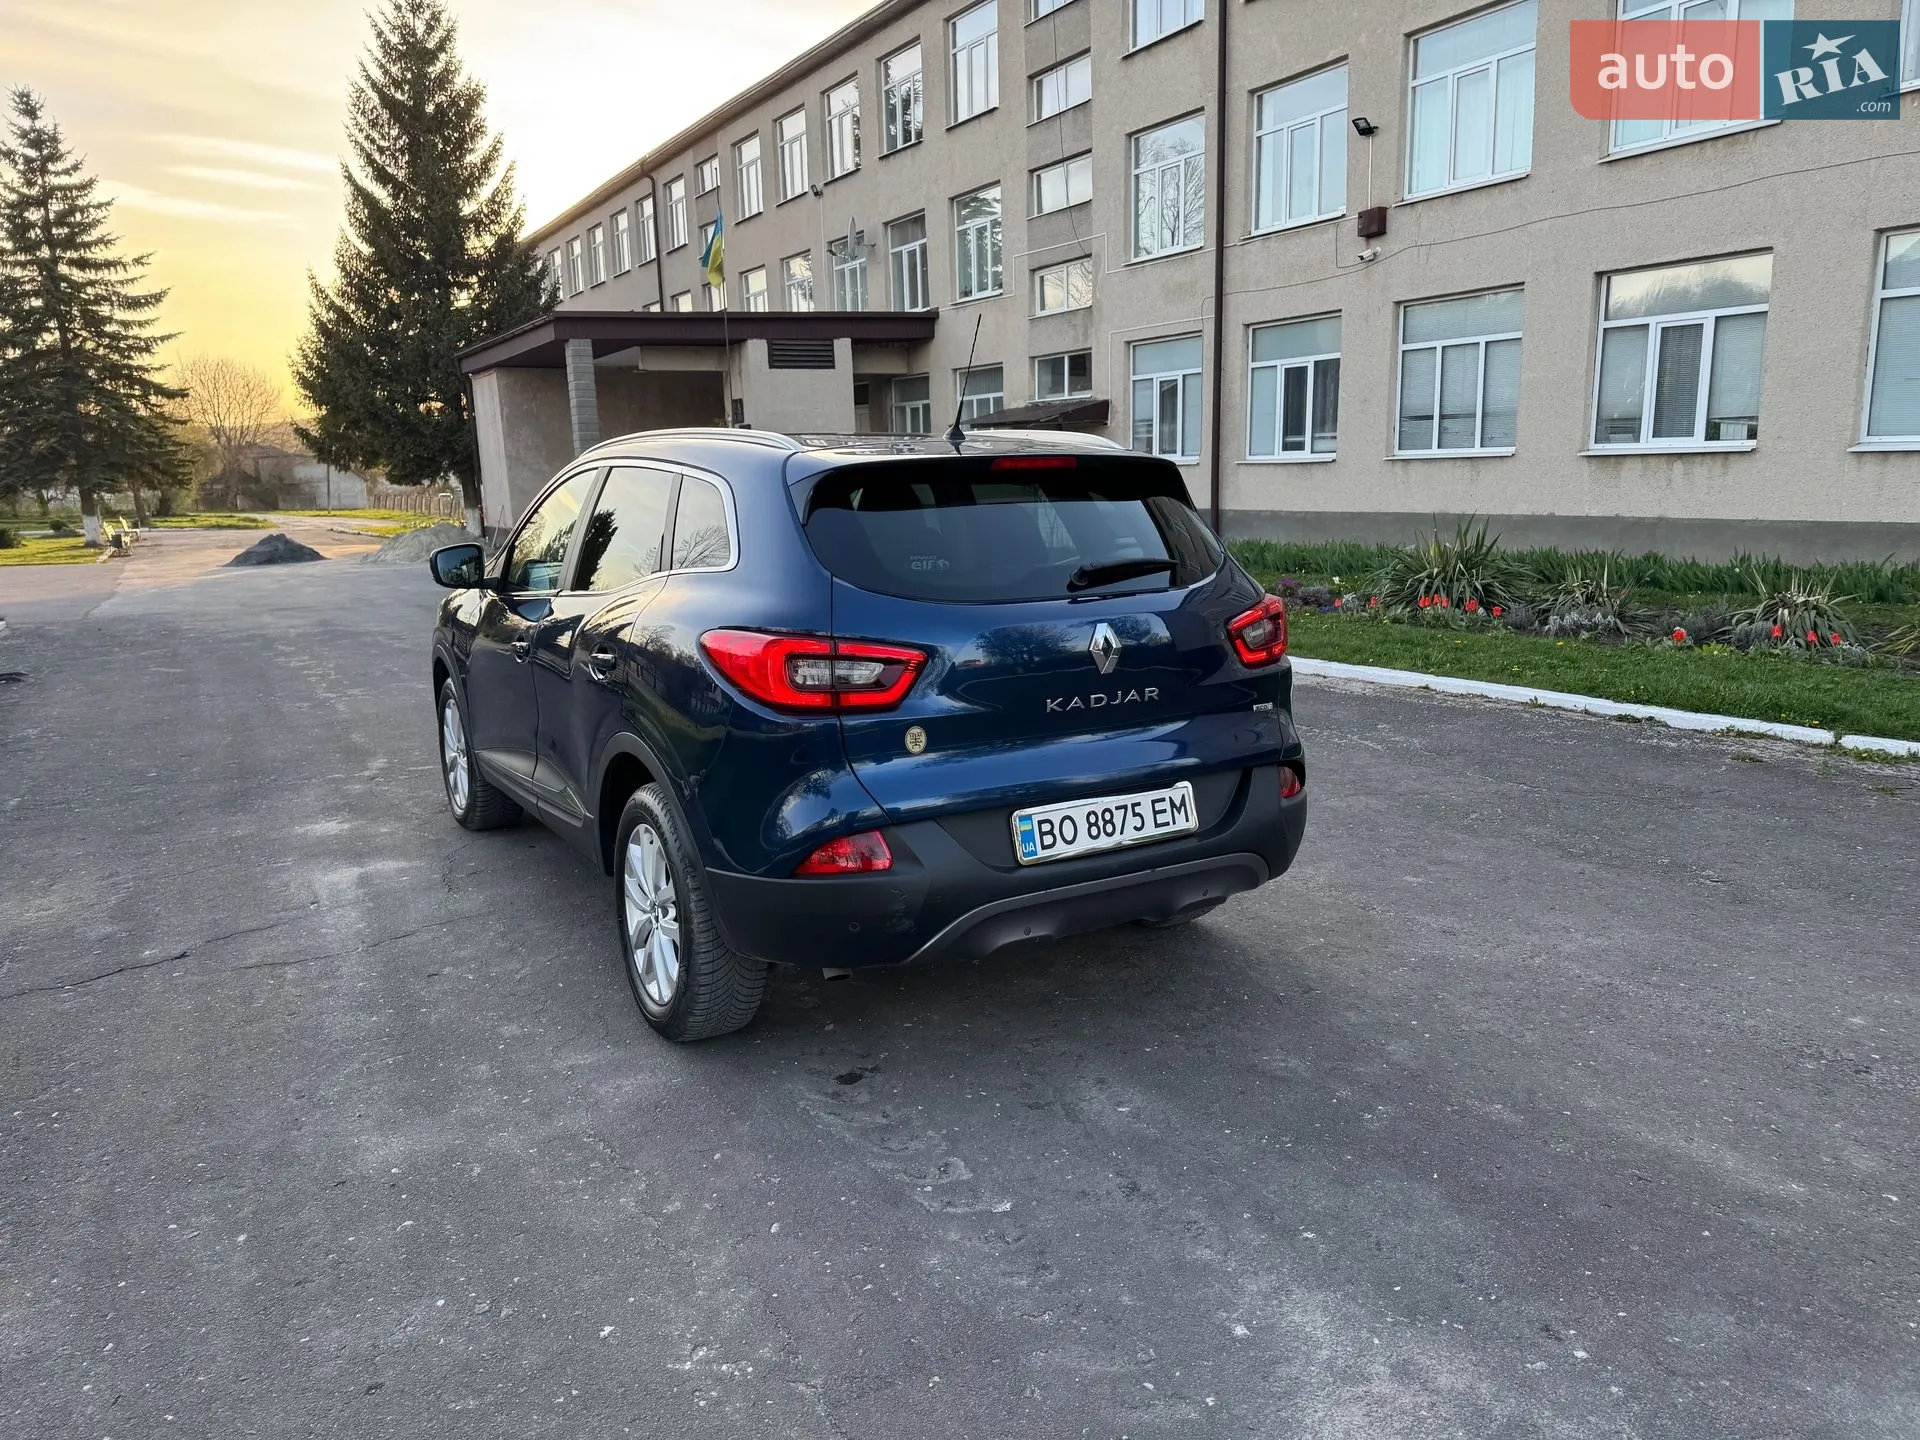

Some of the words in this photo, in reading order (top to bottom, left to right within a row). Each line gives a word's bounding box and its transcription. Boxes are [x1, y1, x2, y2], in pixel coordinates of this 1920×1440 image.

[1046, 687, 1160, 713] KADJAR
[1037, 815, 1078, 850] BO
[1086, 802, 1145, 840] 8875
[1151, 793, 1190, 829] EM
[1022, 842, 1036, 853] UA
